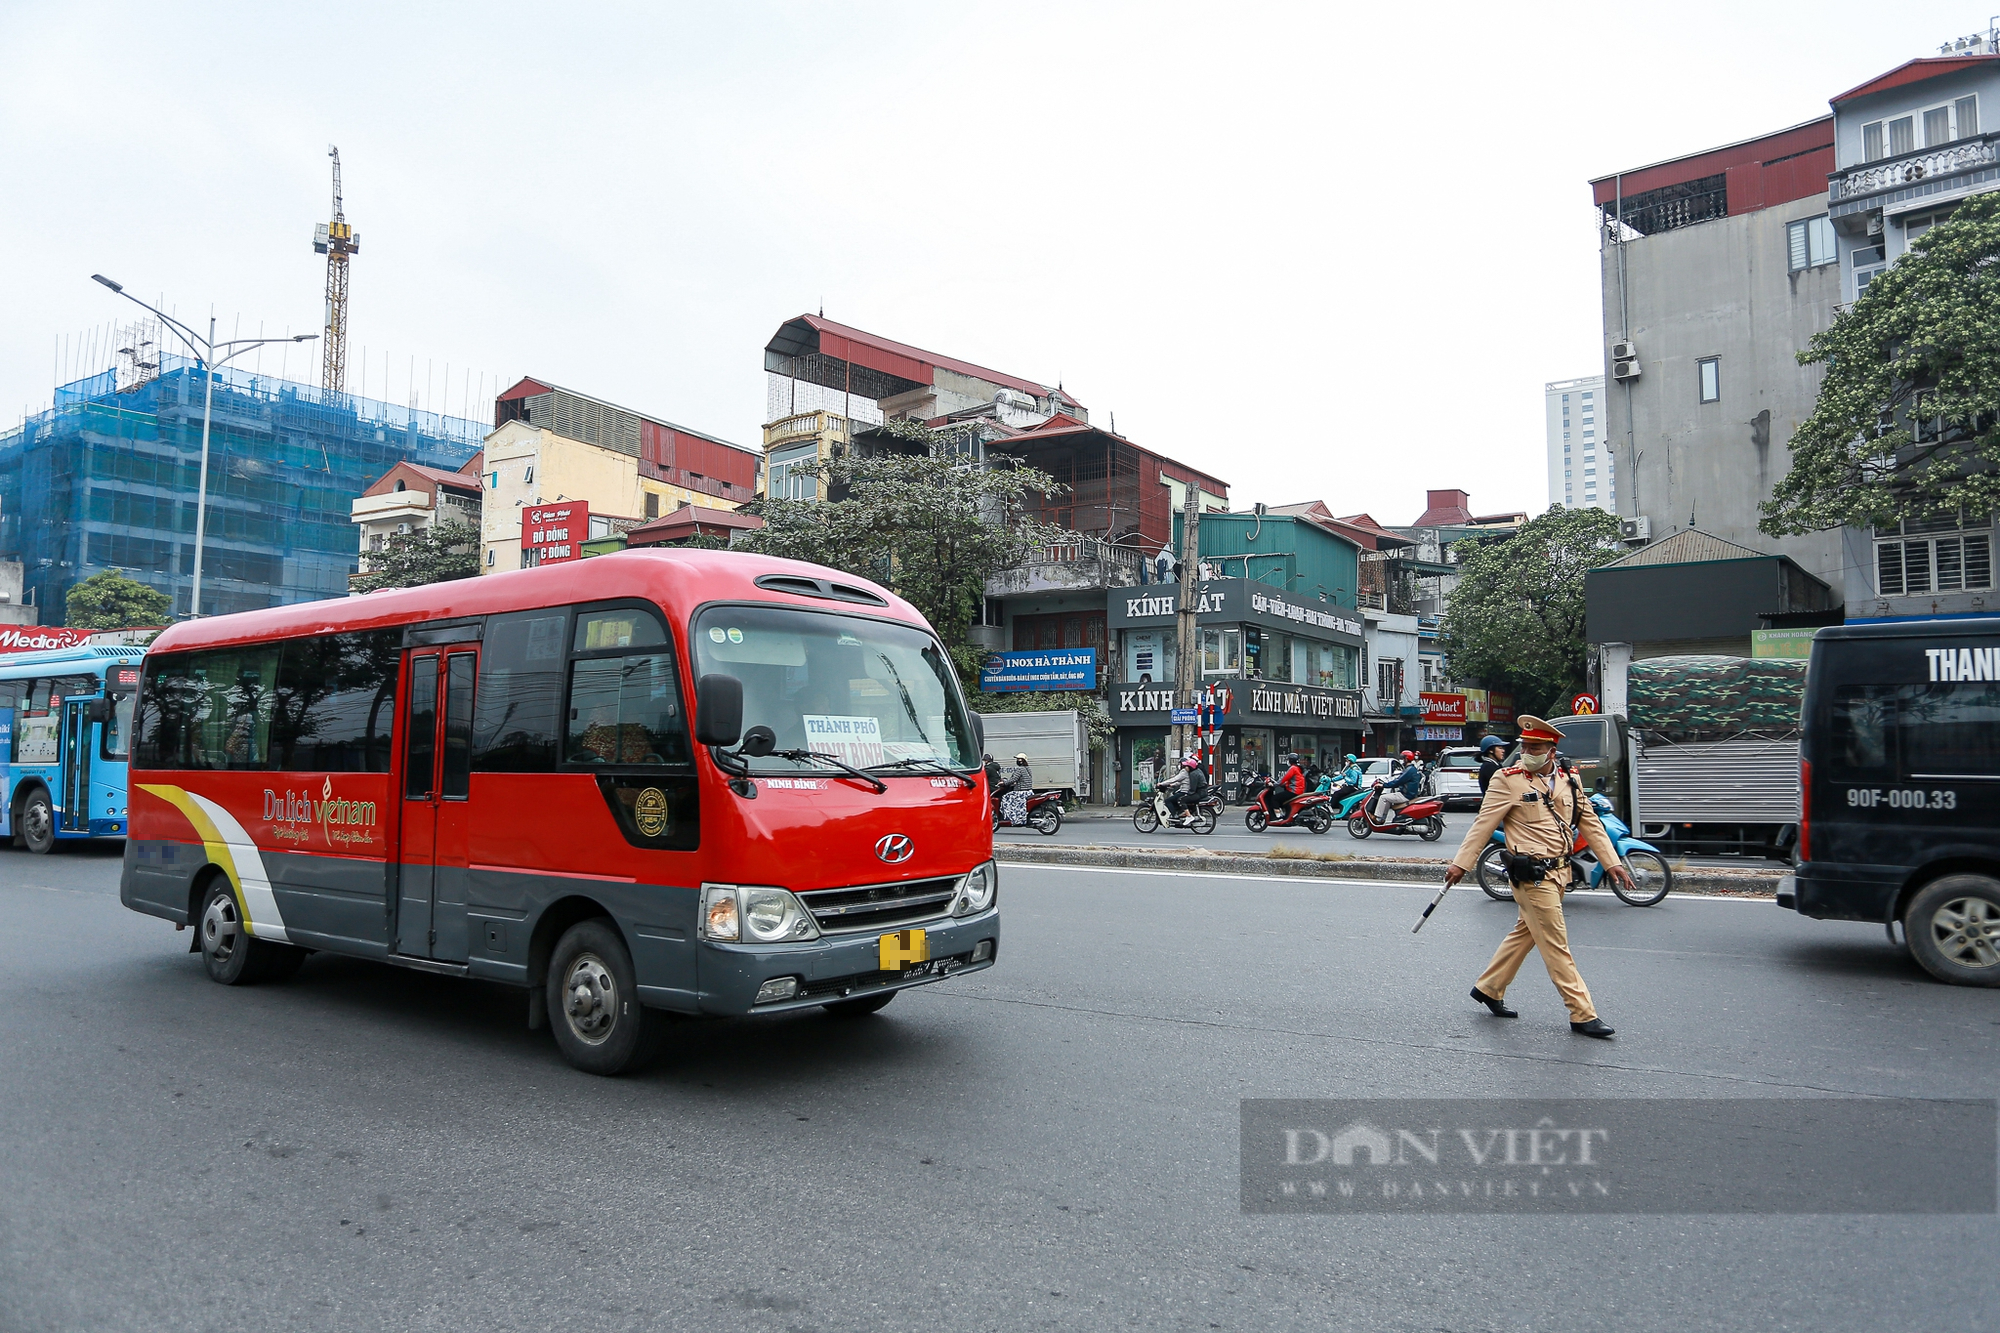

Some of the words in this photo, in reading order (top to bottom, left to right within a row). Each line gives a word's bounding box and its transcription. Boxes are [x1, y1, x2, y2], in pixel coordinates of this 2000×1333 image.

[532, 526, 545, 544] ĐỒ
[546, 525, 569, 542] ĐỒNG
[548, 542, 571, 559] ĐỒNG
[1126, 592, 1175, 617] KÍNH
[1196, 584, 1225, 613] ẮT
[0, 630, 57, 649] Media
[1006, 658, 1035, 668] INOX
[1035, 655, 1051, 667] HÀ
[1051, 653, 1091, 666] THÀNH
[1119, 684, 1174, 711] KÍNH
[1194, 681, 1232, 709] ẮT
[1252, 683, 1281, 712] KÍNH
[1284, 687, 1308, 714] MẮT
[1310, 691, 1334, 719] VIỆT
[1335, 695, 1360, 717] NHÂN
[807, 716, 852, 734] THÀNH
[853, 718, 877, 734] PHỐ
[767, 779, 793, 789] NINH
[793, 778, 818, 790] BÌNH
[1846, 788, 1957, 809] 90F-000.33
[263, 788, 284, 821] Du
[285, 788, 311, 829] lịch
